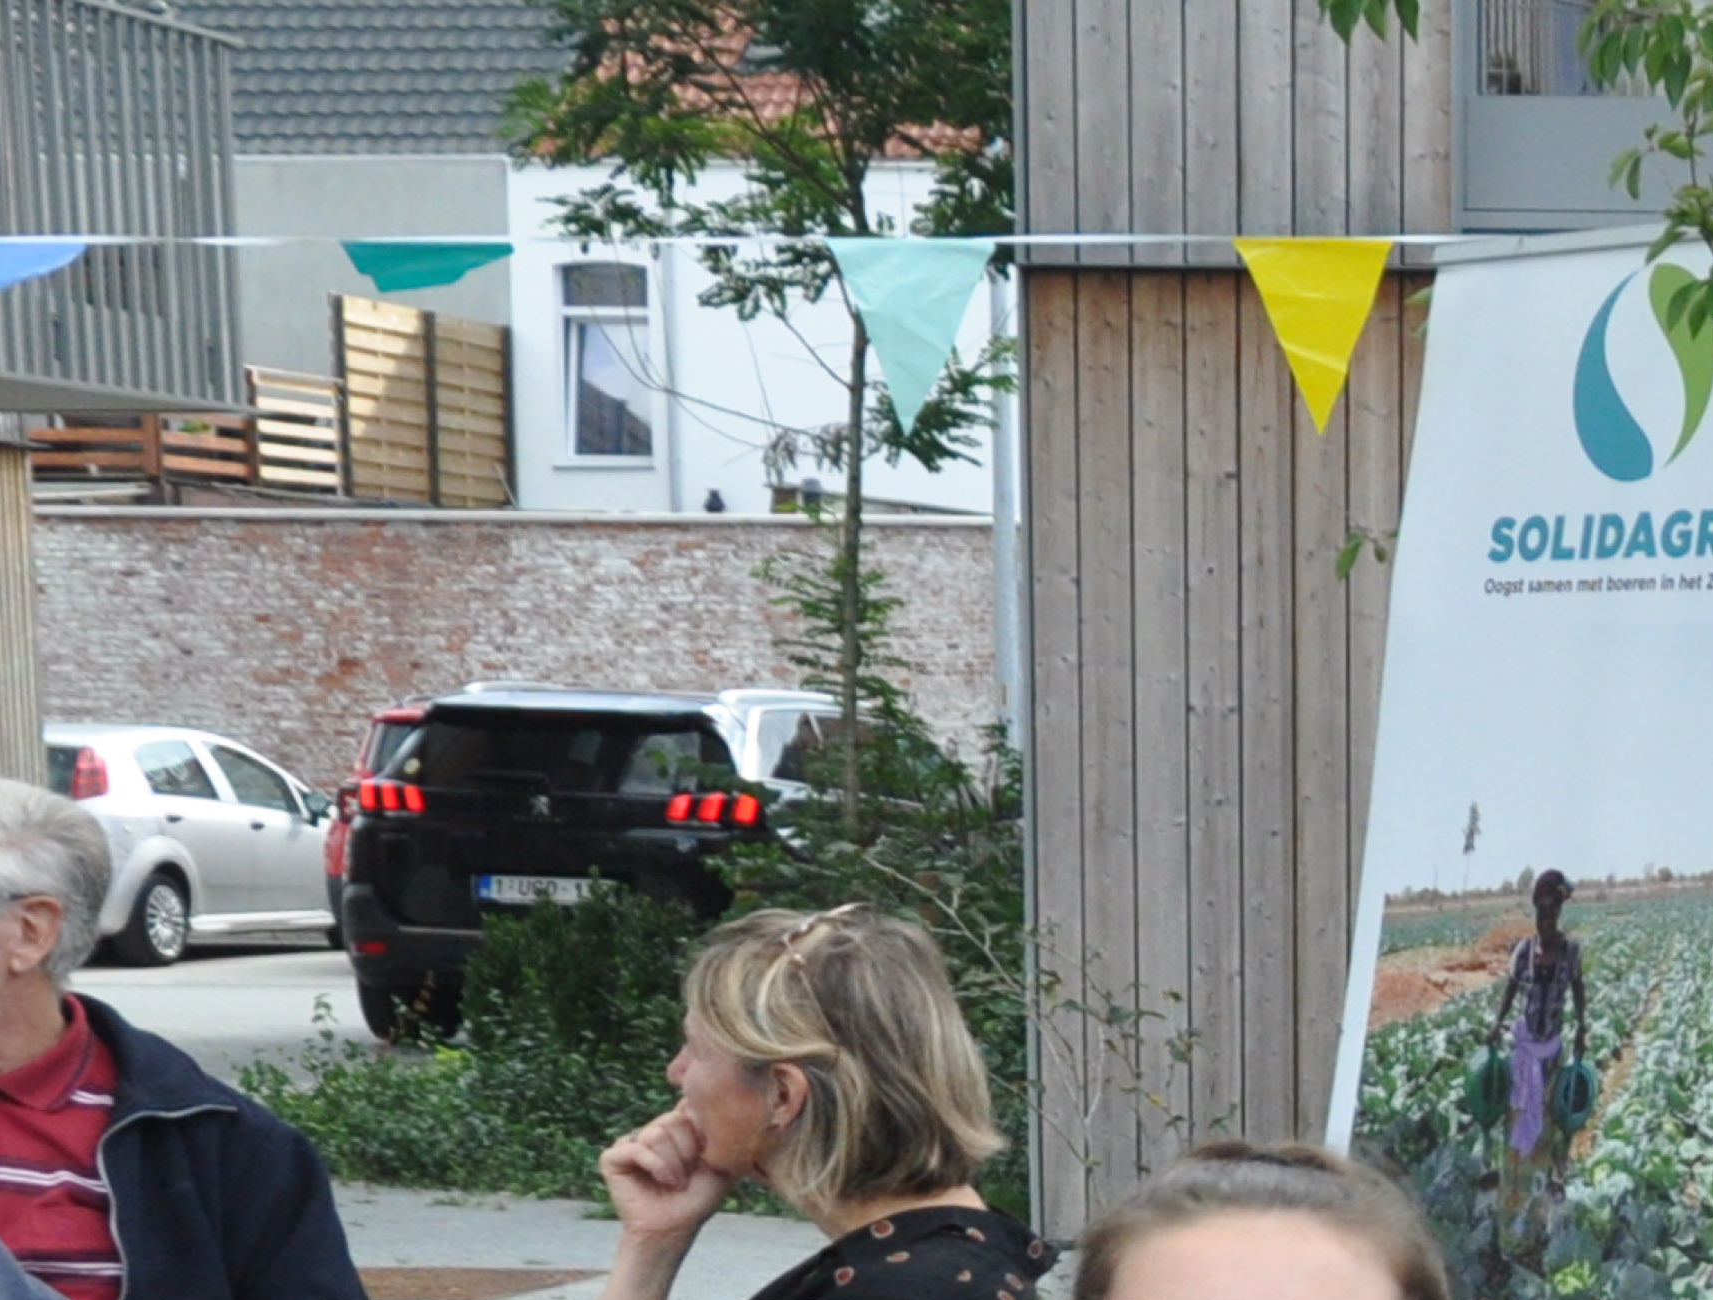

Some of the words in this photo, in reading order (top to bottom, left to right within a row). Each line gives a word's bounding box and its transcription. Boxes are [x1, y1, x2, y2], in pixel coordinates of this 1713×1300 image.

[1484, 577, 1524, 597] Oogst
[1528, 577, 1573, 594] samen
[1577, 576, 1603, 592] met
[1606, 574, 1657, 592] boeren
[1661, 573, 1675, 591] in
[1678, 572, 1703, 591] het
